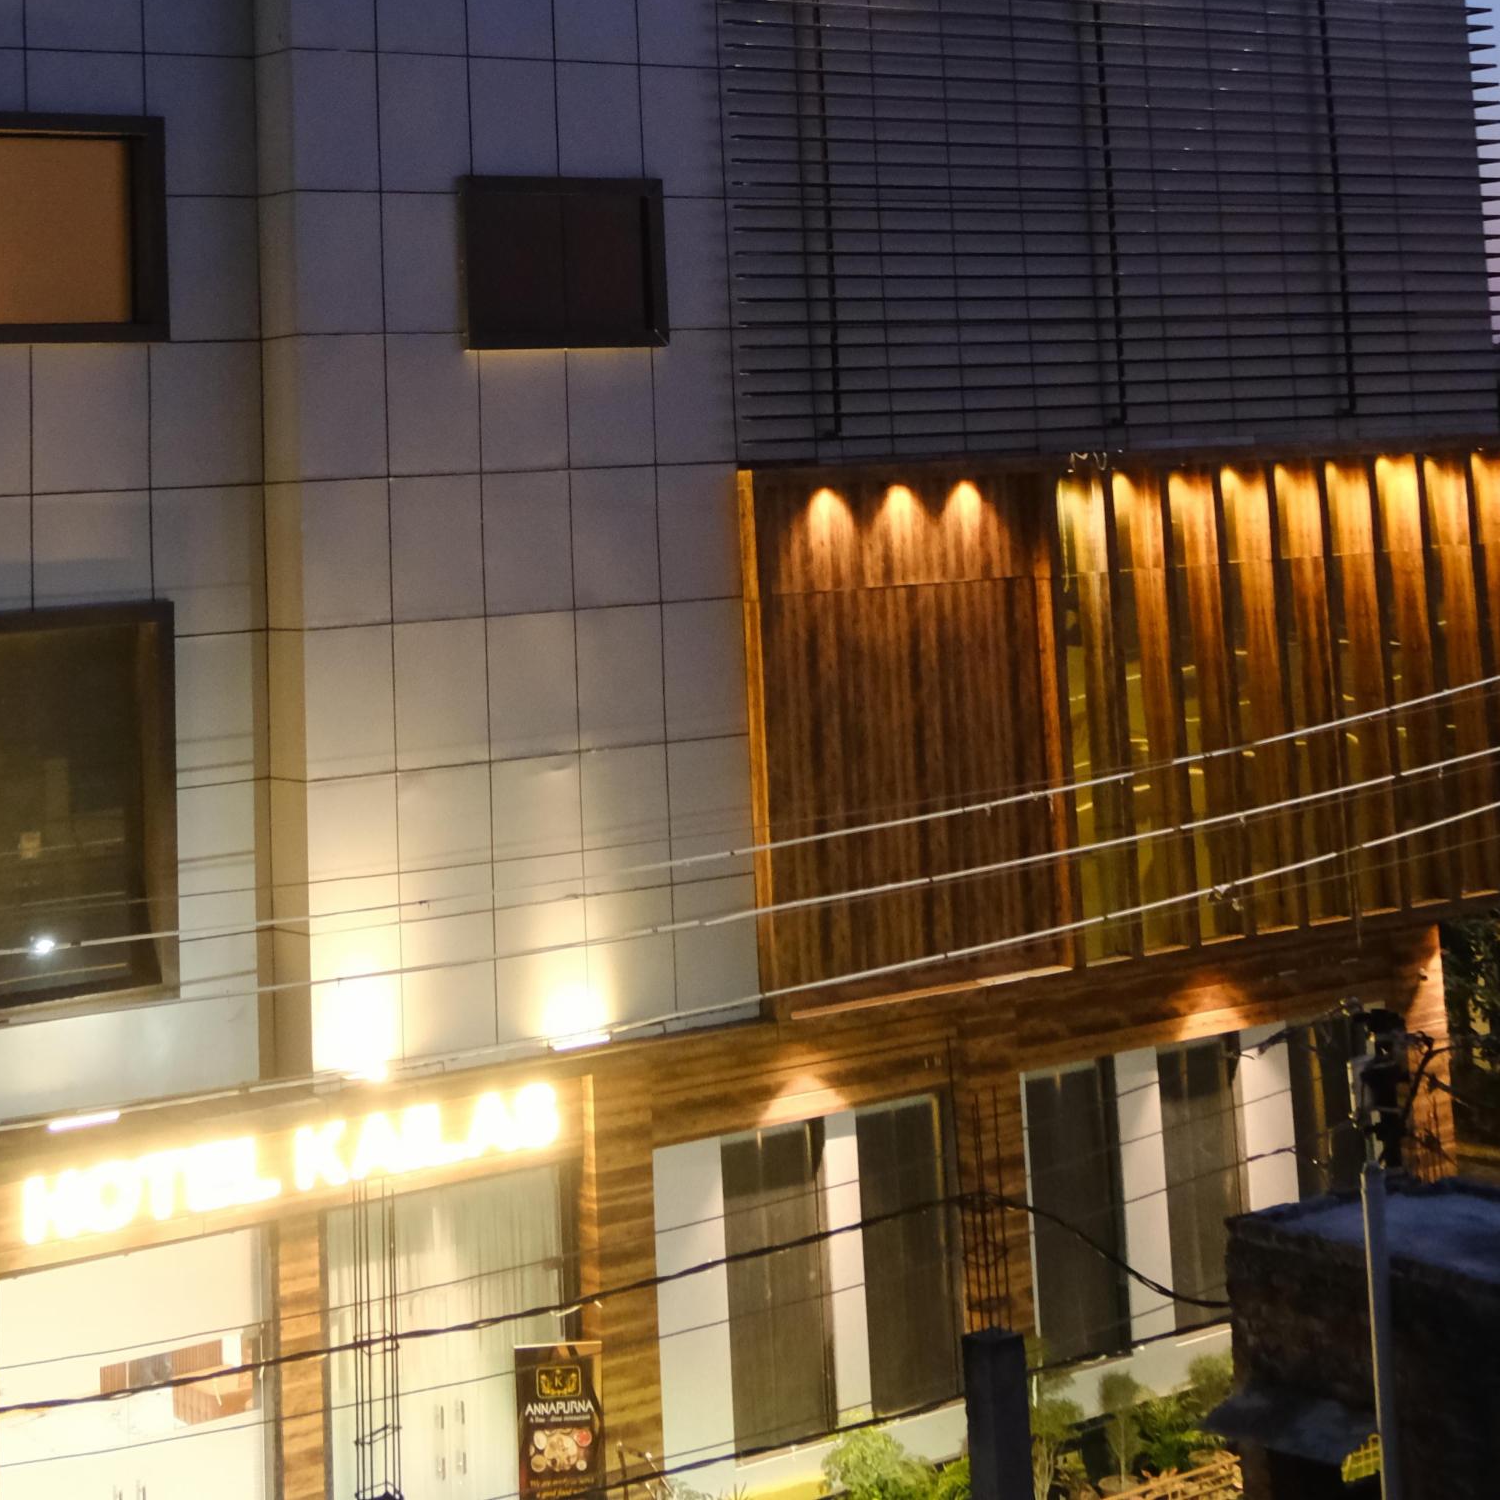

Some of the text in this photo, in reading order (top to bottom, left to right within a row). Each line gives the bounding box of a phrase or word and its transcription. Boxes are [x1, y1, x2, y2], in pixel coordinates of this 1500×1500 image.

[22, 1081, 562, 1245] HOTEL KAILAS
[525, 1400, 594, 1416] ANNAPURNA
